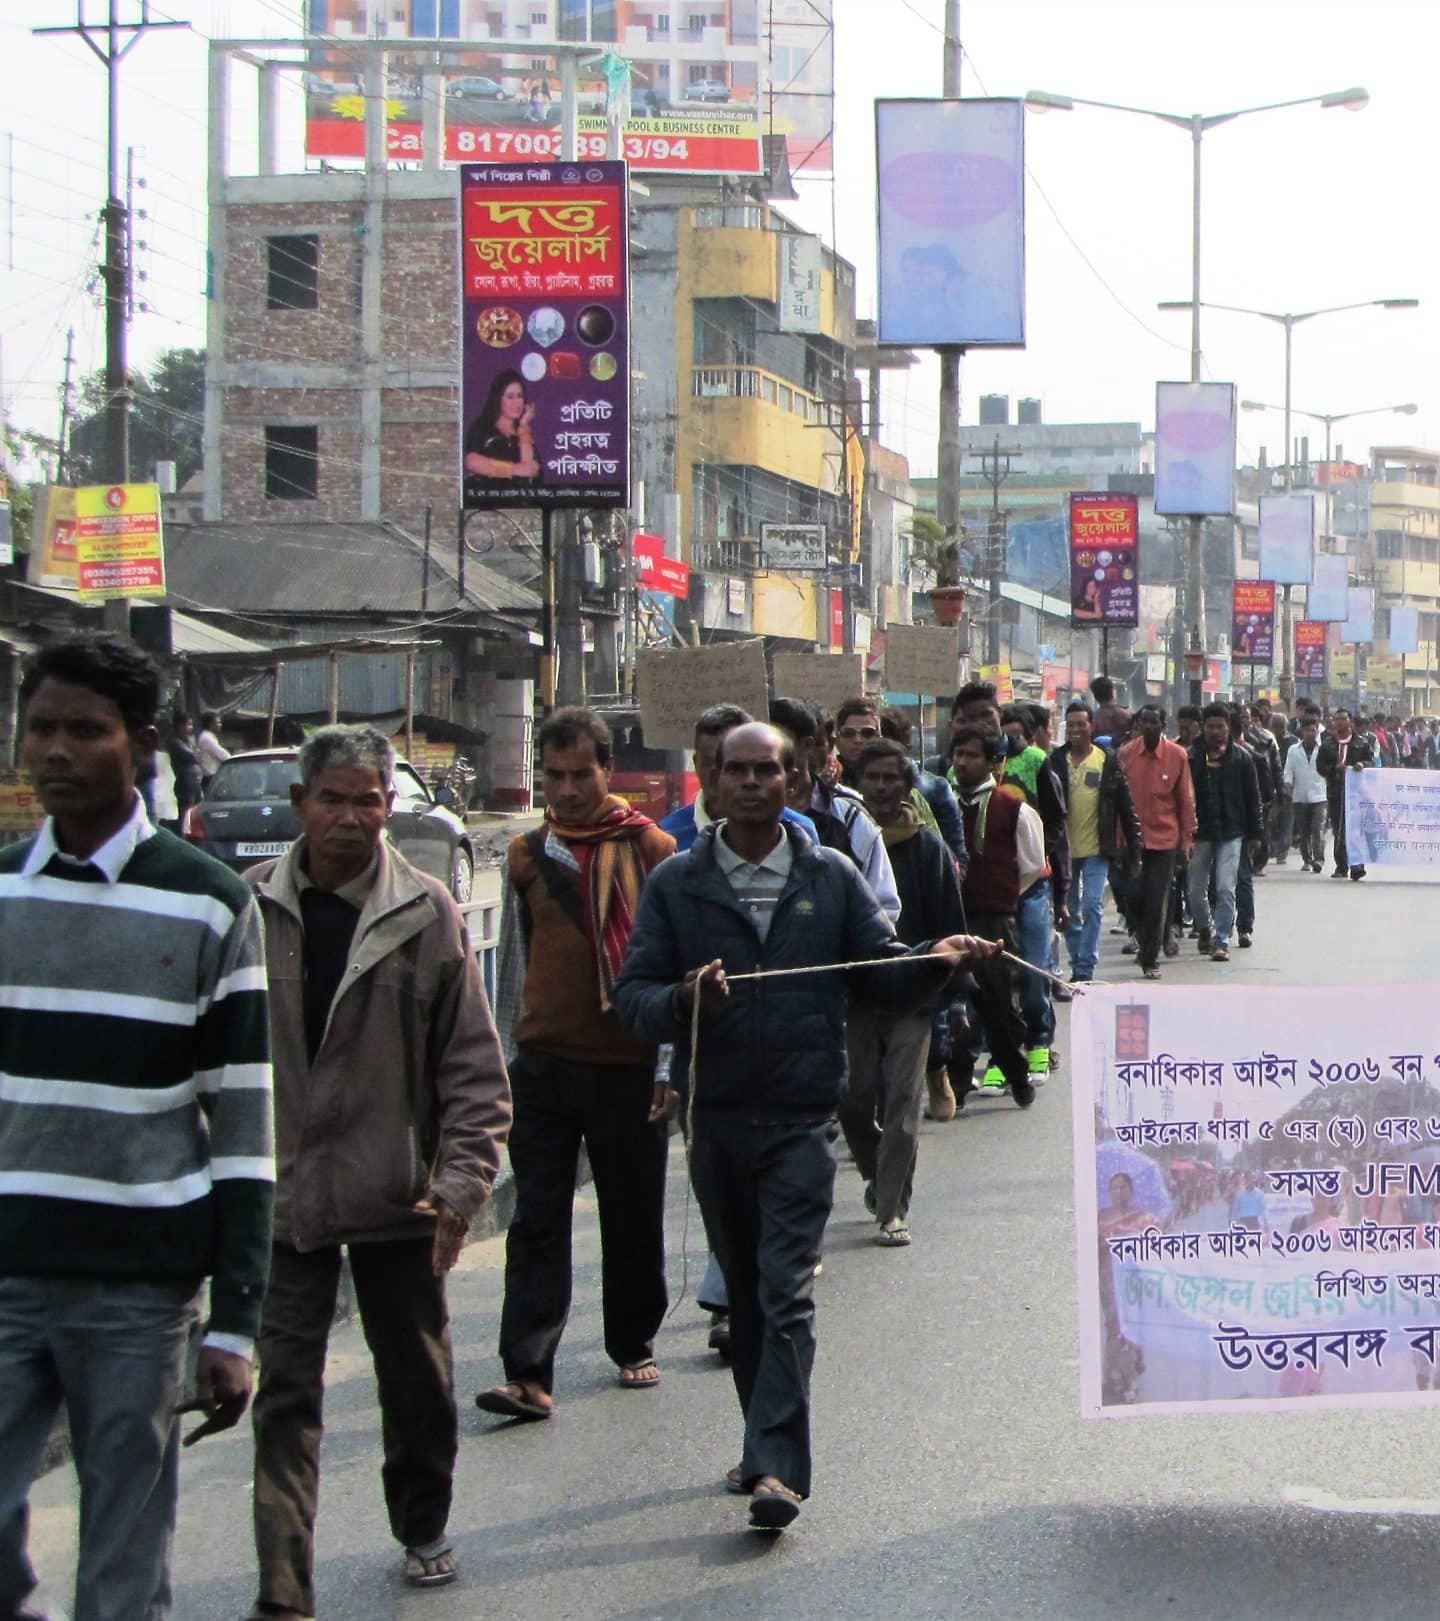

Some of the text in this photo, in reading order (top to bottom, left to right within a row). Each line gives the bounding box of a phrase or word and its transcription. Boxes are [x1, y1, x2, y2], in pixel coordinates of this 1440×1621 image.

[627, 121, 650, 132] POOL
[654, 122, 660, 132] &
[663, 122, 704, 134] BUSINESS
[706, 123, 740, 135] CENTRE
[474, 200, 608, 234] দত্ত
[469, 225, 612, 272] জুয়েলার্স
[560, 400, 613, 423] প্রতিটি
[1114, 1052, 1224, 1088] বনাধিকার
[1232, 1051, 1298, 1088] আইন
[1308, 1056, 1380, 1087] ২০০৬
[1390, 1053, 1424, 1084] বন
[1114, 1118, 1198, 1146] আইনের
[1206, 1118, 1249, 1142] ধারা
[1258, 1120, 1274, 1140] ৫
[1285, 1120, 1320, 1139] এর
[1329, 1117, 1364, 1146] (ঘ)
[1375, 1116, 1420, 1141] এবং
[1268, 1169, 1342, 1198] সমস্ত
[1108, 1226, 1201, 1262] বনাধিকার
[1207, 1224, 1262, 1258] আইন
[1271, 1229, 1332, 1256] ২০০৬
[1340, 1220, 1416, 1252] আইনের
[1314, 1269, 1388, 1298] লিখিত
[1212, 1322, 1389, 1372] উত্তরবঙ্গ
